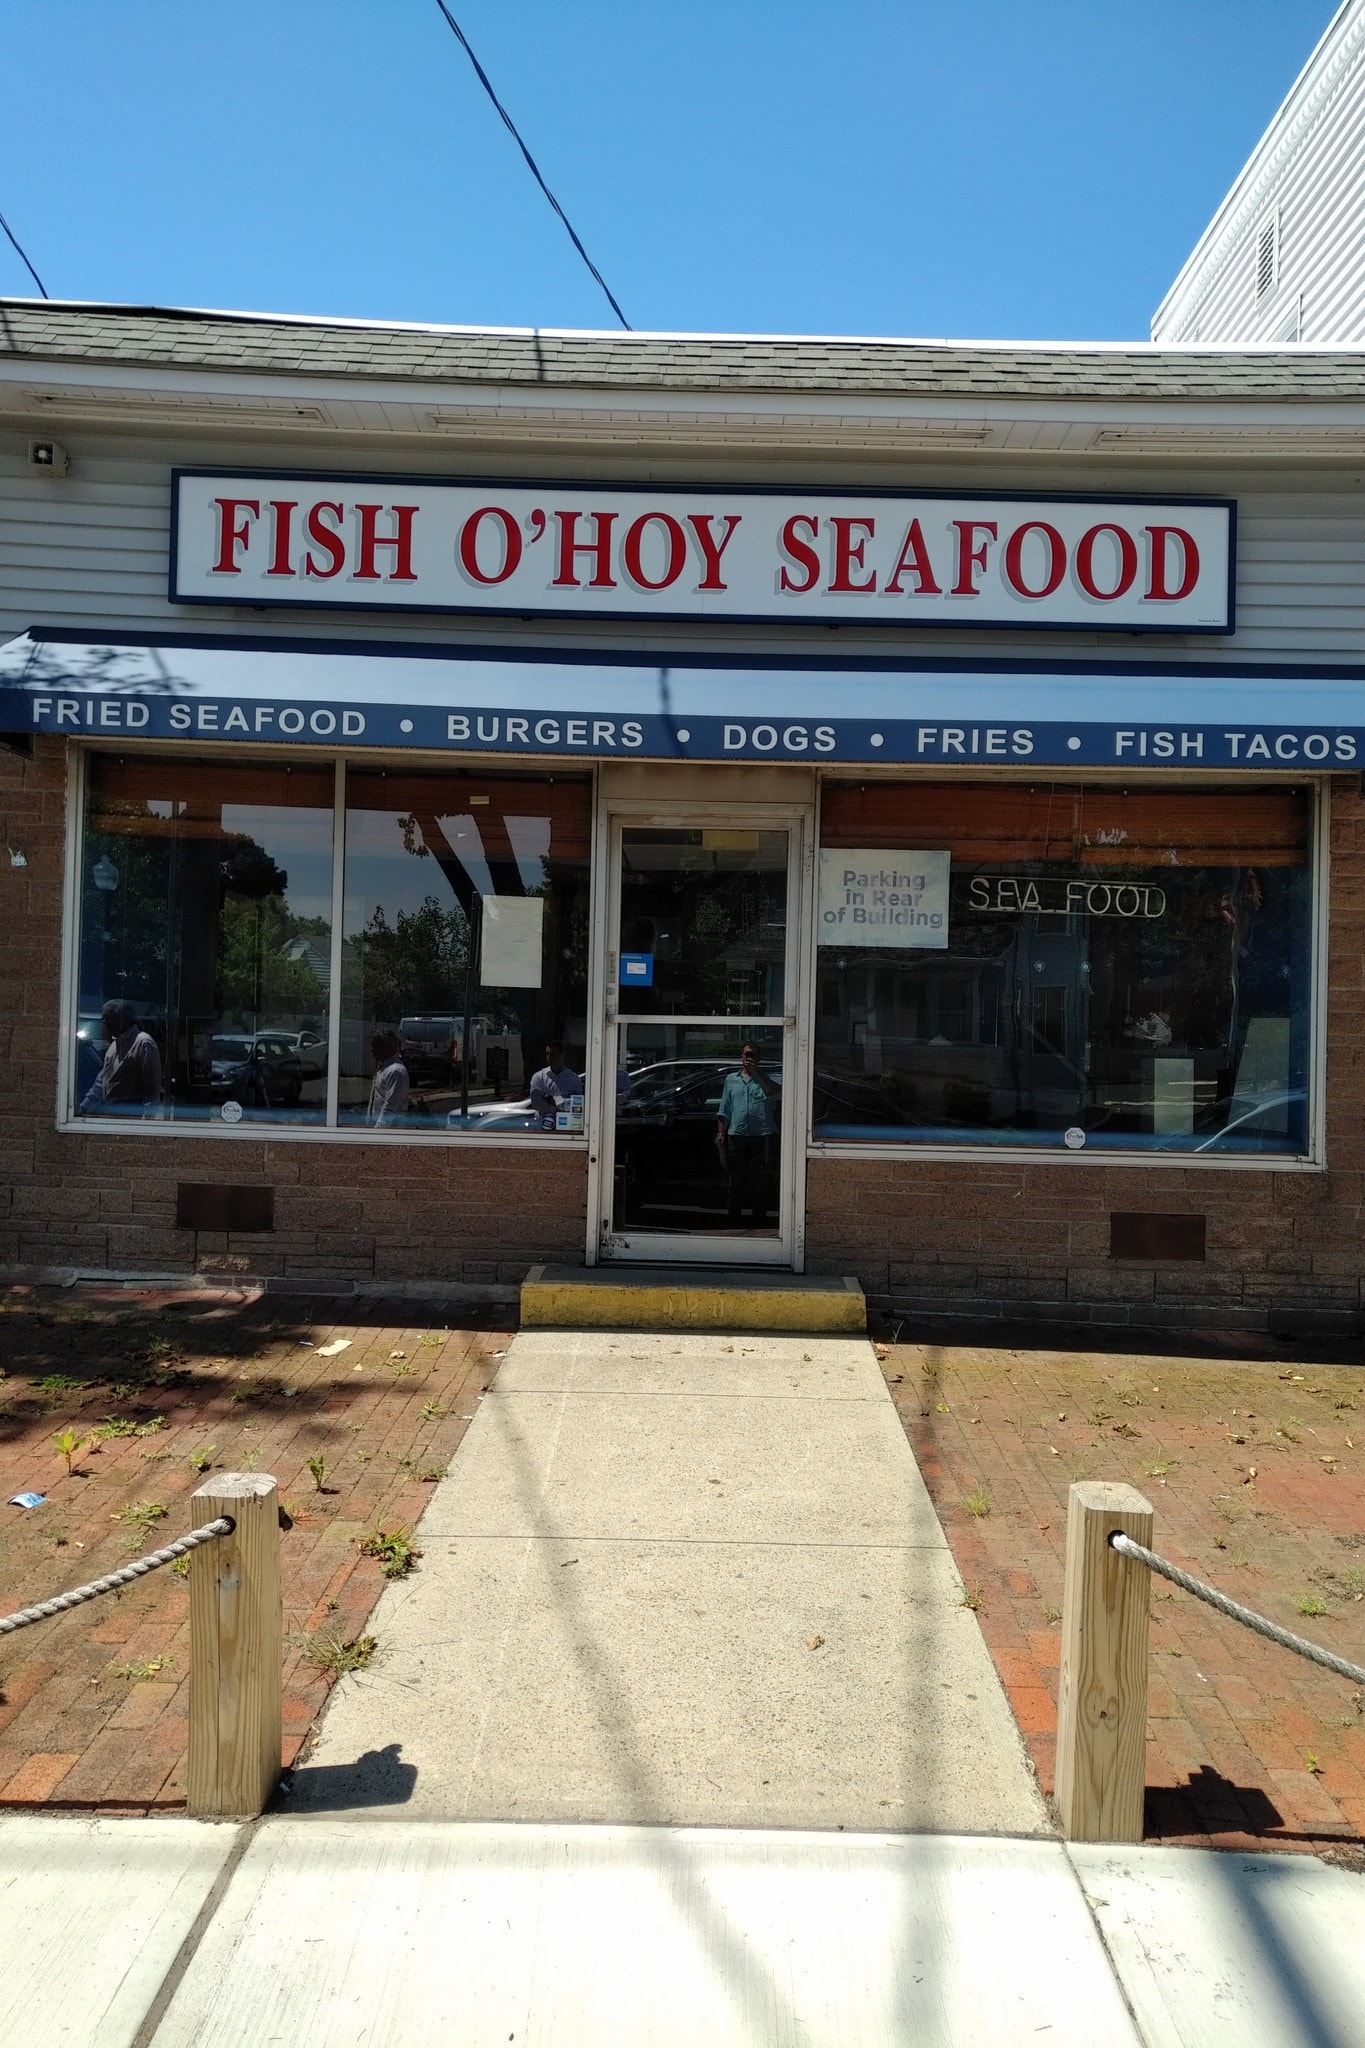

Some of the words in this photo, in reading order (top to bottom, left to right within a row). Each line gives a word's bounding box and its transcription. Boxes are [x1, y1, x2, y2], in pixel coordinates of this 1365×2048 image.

[209, 498, 420, 581] FISH
[458, 506, 742, 592] O'HOY
[780, 514, 1200, 601] SEAFOOD
[31, 697, 149, 728] FRIED
[169, 703, 367, 738] SEAFOOD
[447, 715, 644, 748] BURGERS
[723, 724, 837, 753] DOGS
[917, 728, 1035, 756] FRIES
[1115, 731, 1204, 758] FISH
[1224, 733, 1358, 761] TACOS
[843, 870, 926, 891] Parking
[845, 888, 865, 905] in
[872, 889, 923, 906] Rear
[968, 878, 1042, 911] SEA
[1066, 881, 1166, 918] FOOD
[823, 907, 846, 924] of
[853, 908, 943, 929] Building
